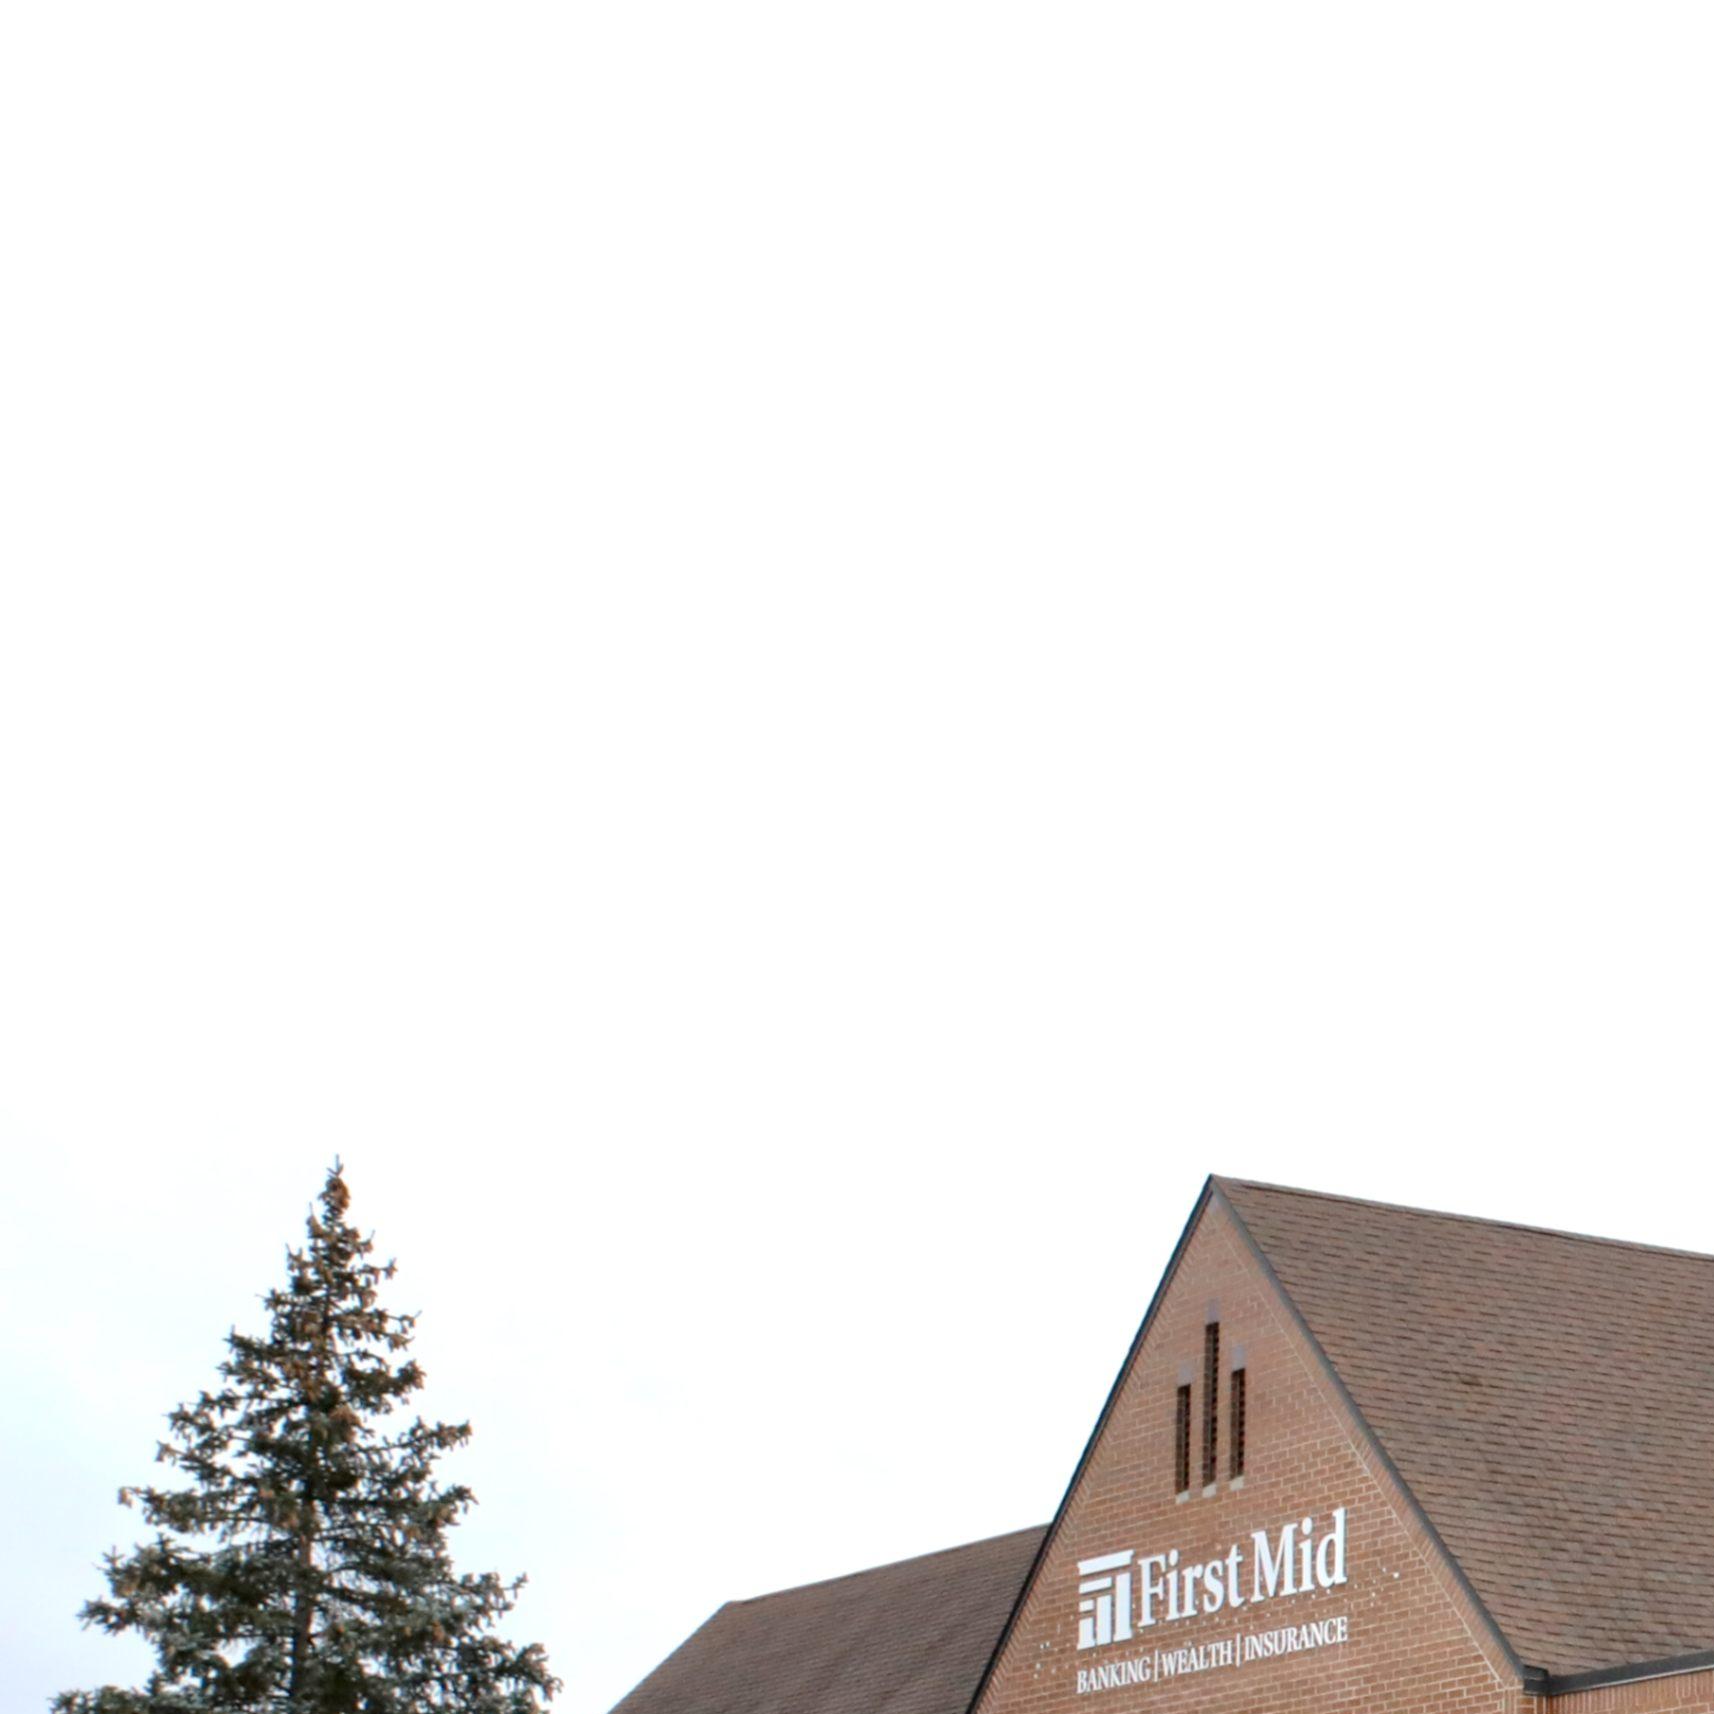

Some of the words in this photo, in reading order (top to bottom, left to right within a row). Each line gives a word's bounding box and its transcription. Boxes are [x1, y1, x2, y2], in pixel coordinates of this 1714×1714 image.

[1137, 1543, 1244, 1628] First
[1250, 1506, 1347, 1603] Mid
[1076, 1656, 1150, 1694] BANKING
[1161, 1639, 1233, 1677] WEALTH
[1244, 1616, 1348, 1661] INSURANCE
